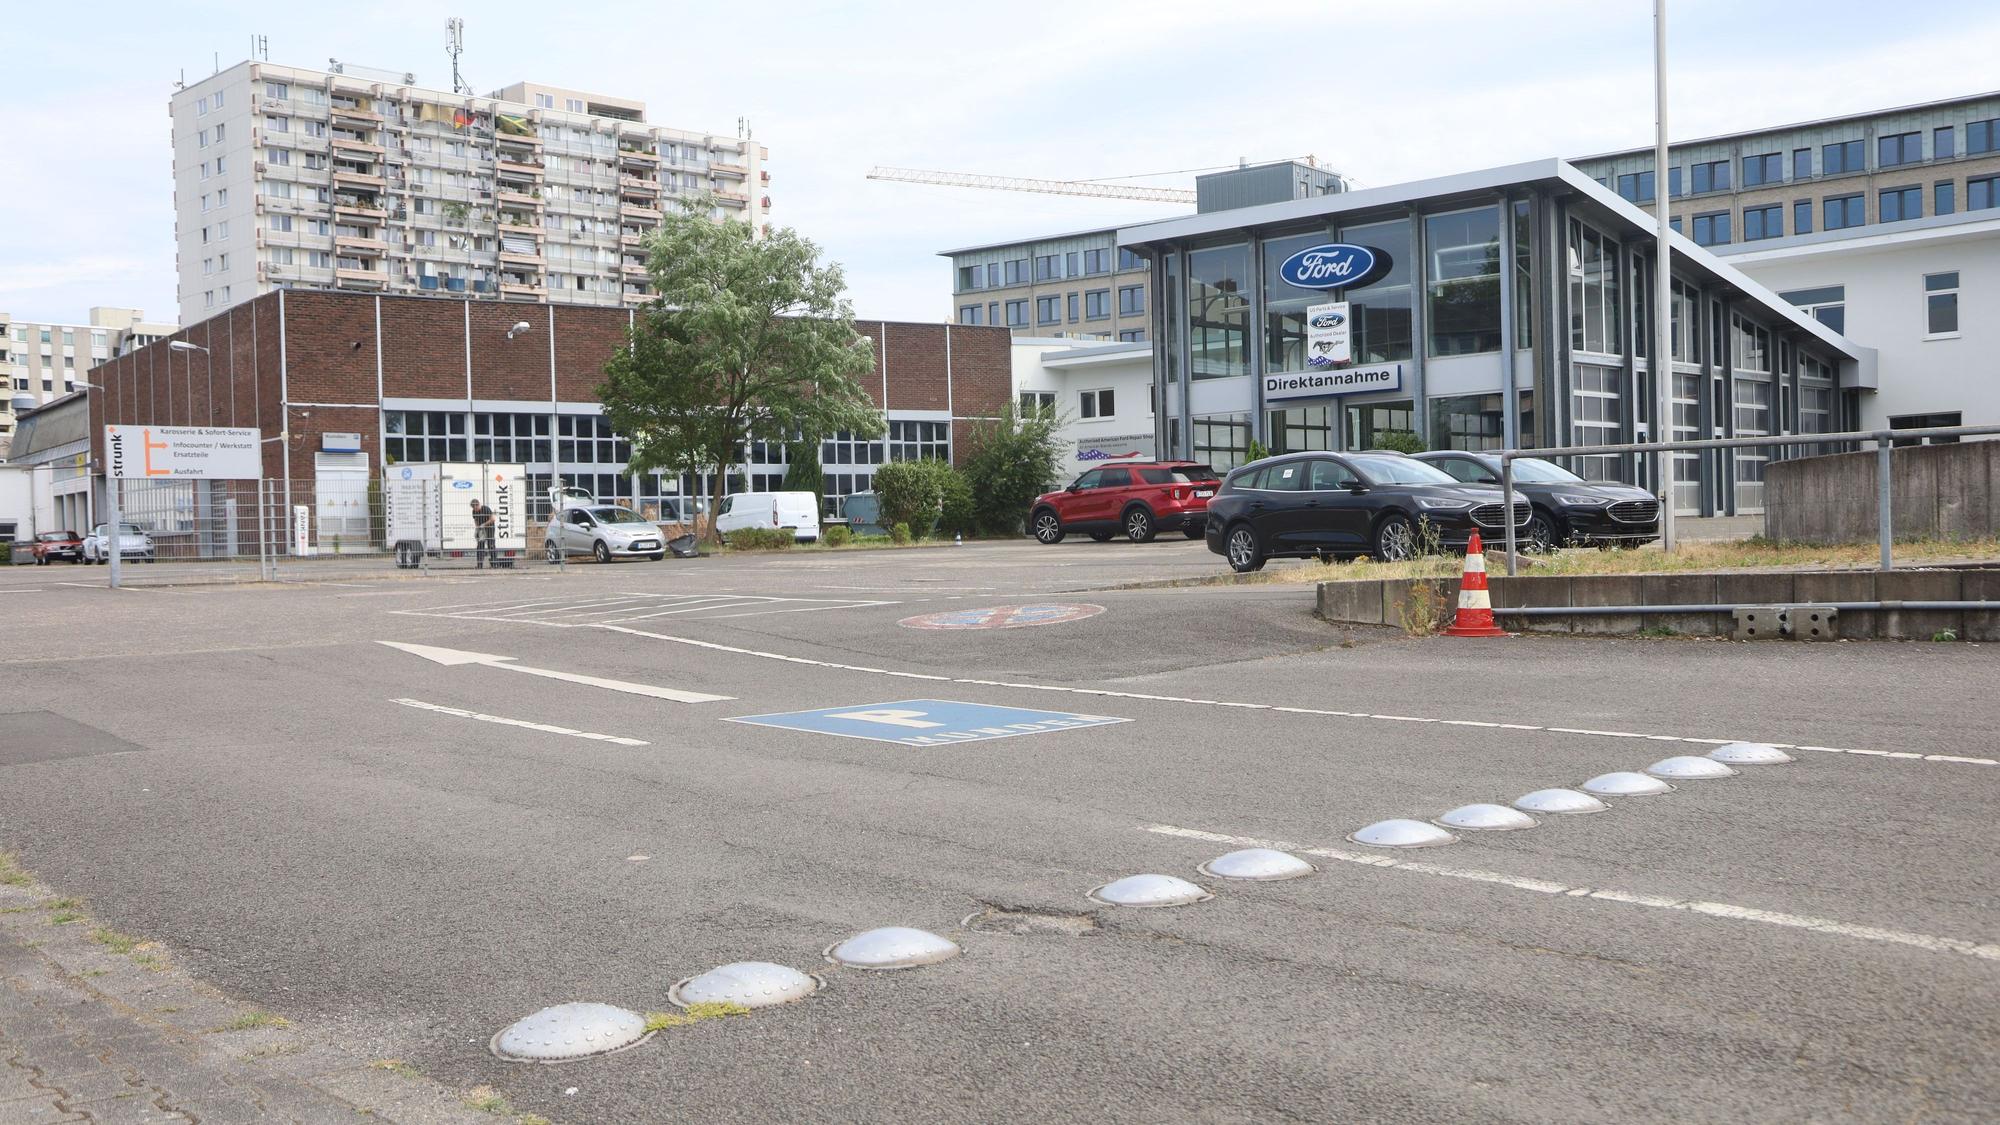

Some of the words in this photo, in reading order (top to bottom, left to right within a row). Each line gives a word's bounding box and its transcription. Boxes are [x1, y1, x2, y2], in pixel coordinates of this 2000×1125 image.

[1297, 250, 1354, 281] Ford
[1316, 315, 1338, 327] Ford
[1267, 370, 1390, 391] Direktannahme
[160, 428, 196, 436] Karosserie
[205, 429, 252, 437] Sofort-Service
[111, 434, 123, 477] strunk
[496, 485, 509, 539] strunk
[823, 708, 947, 729] P
[899, 714, 1114, 744] KUNDEN
